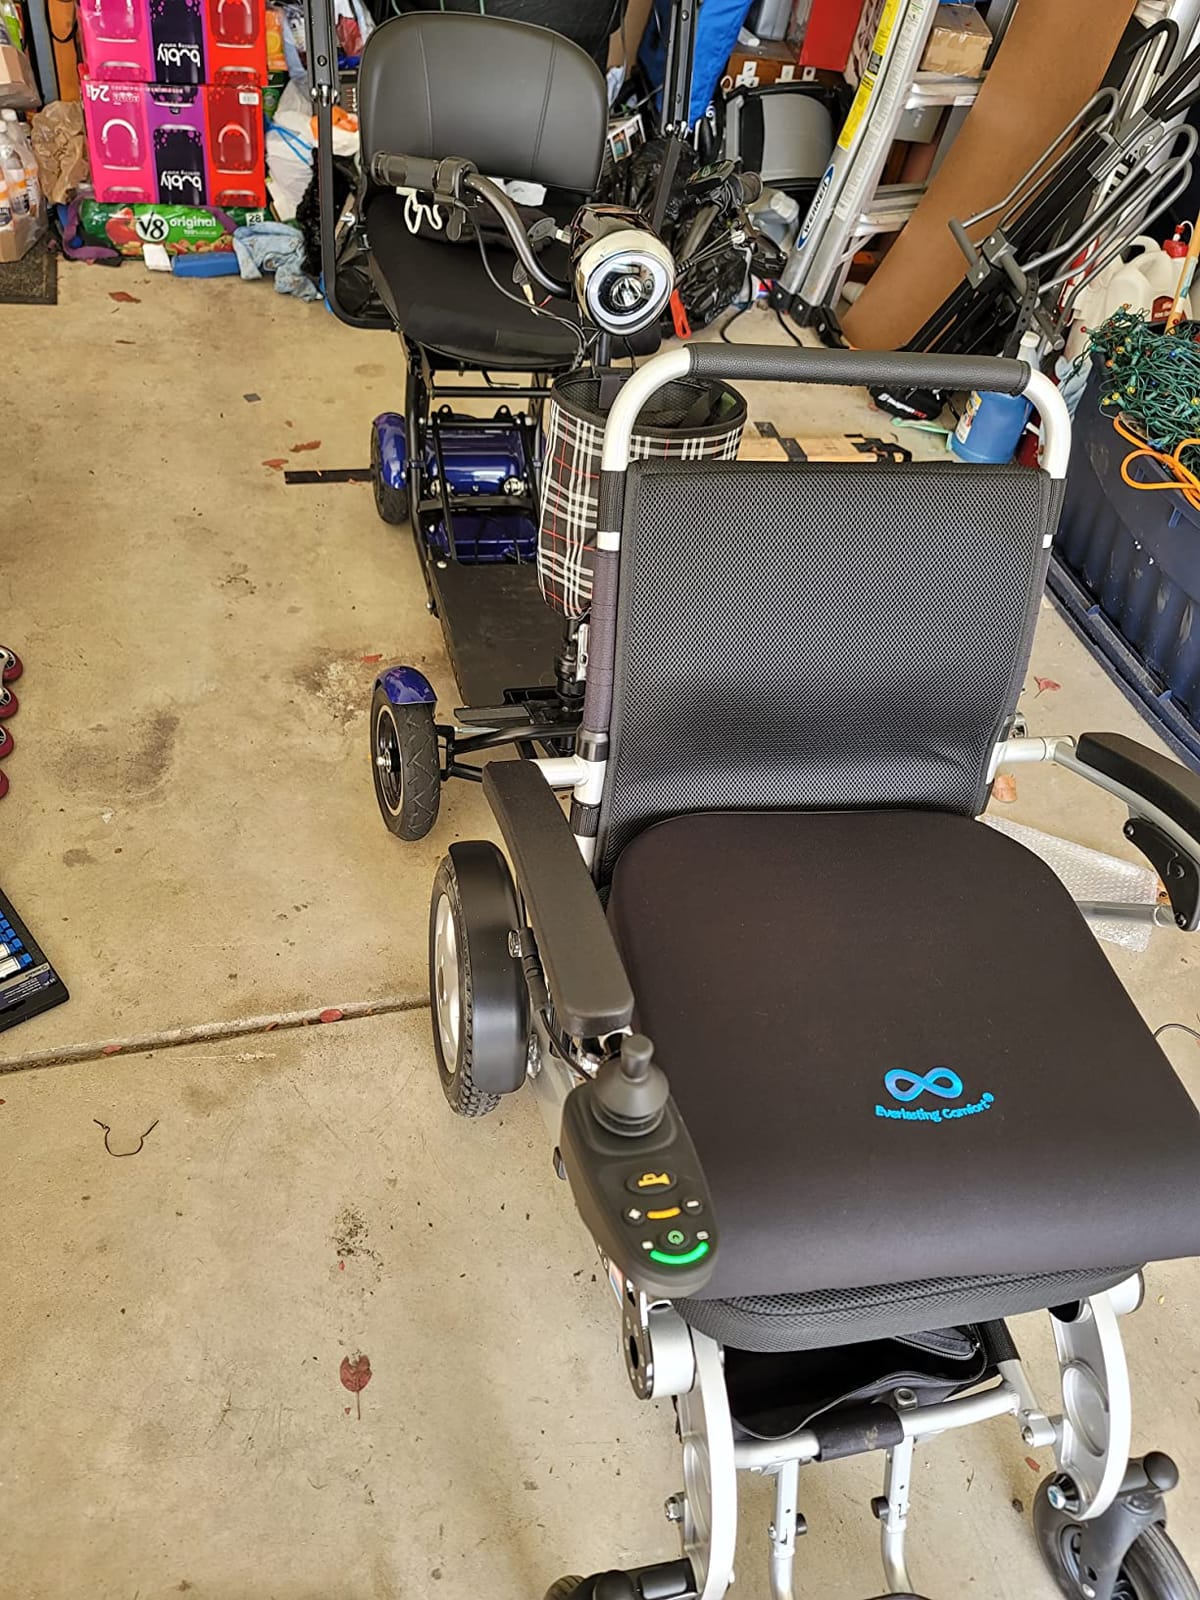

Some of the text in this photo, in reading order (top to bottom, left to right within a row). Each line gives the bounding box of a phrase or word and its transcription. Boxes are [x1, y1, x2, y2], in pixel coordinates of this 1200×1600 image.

[157, 42, 201, 67] bubly
[160, 170, 202, 192] bubly
[804, 181, 828, 233] WERNER
[139, 211, 217, 240] V8 original
[248, 214, 262, 224] 28
[875, 1104, 942, 1123] Everlasting
